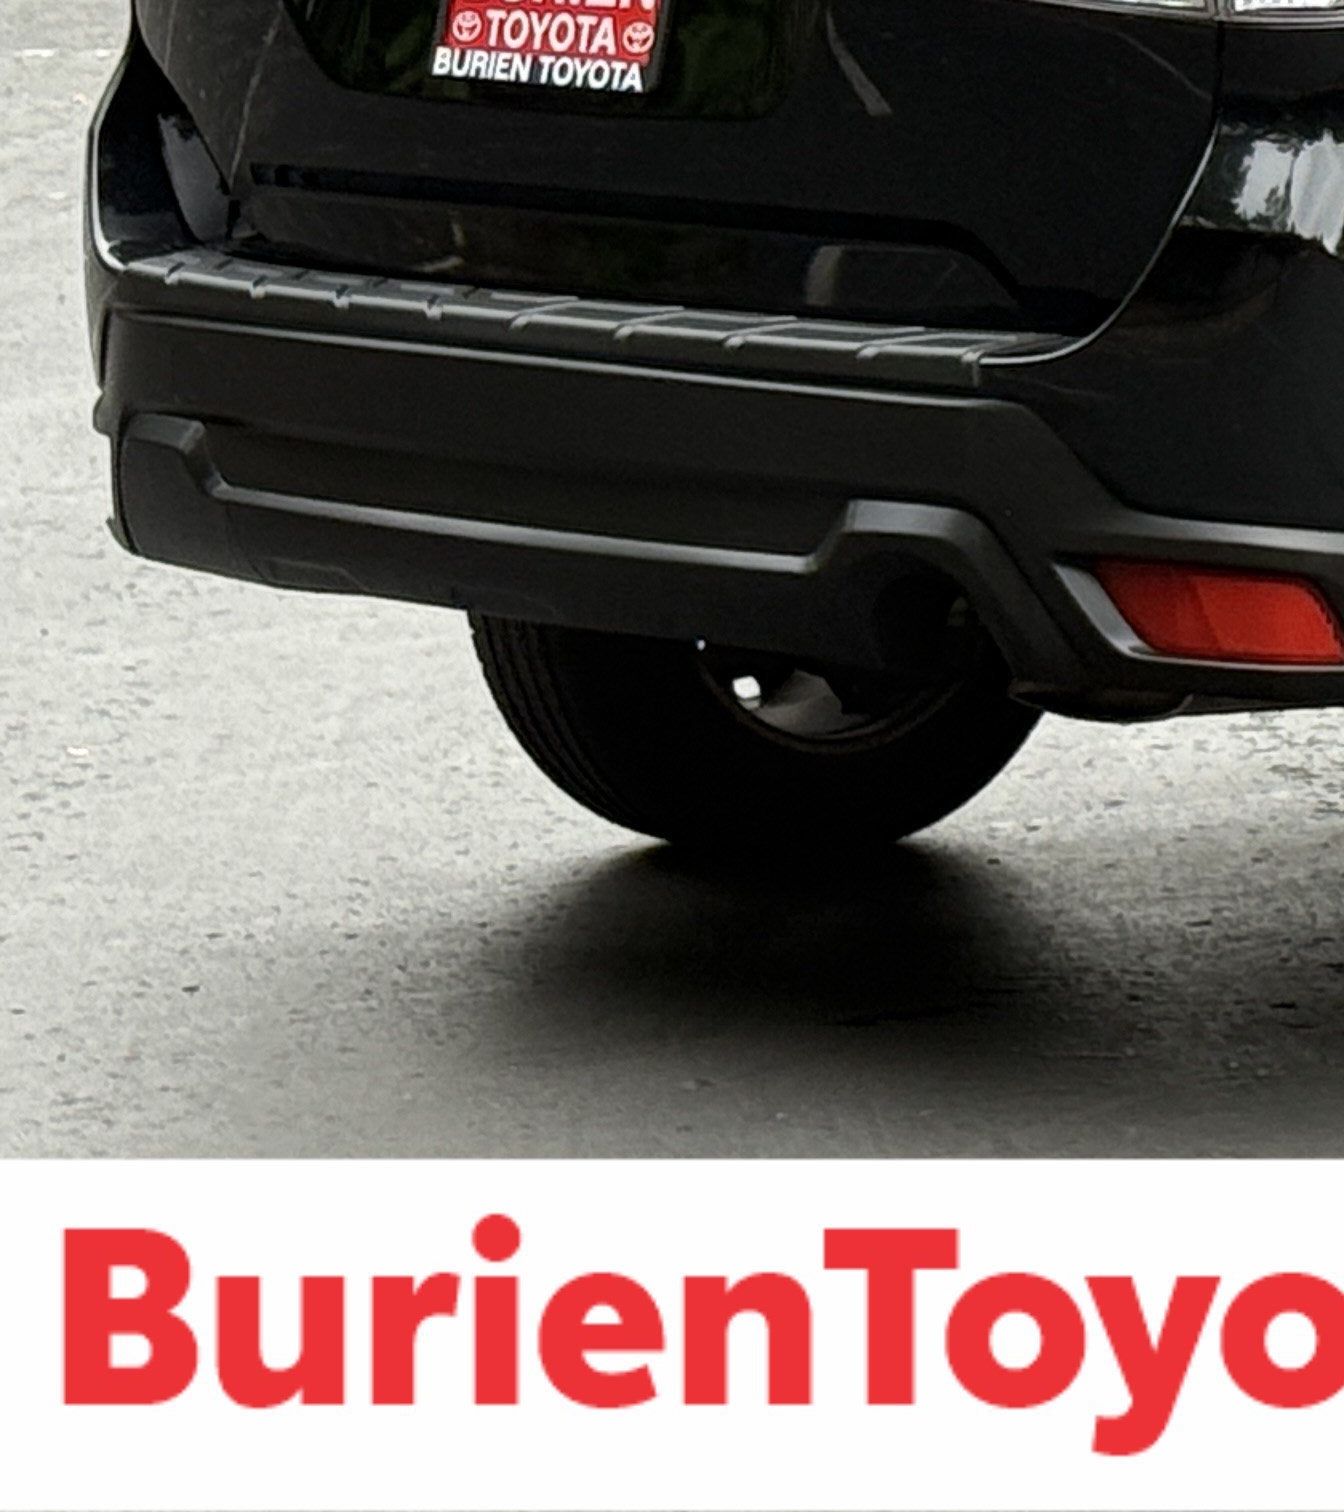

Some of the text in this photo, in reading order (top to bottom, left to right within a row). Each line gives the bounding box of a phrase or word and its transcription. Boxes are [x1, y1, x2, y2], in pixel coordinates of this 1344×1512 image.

[485, 8, 617, 55] TOYOTA
[431, 45, 644, 93] BURIEN TOYOTA
